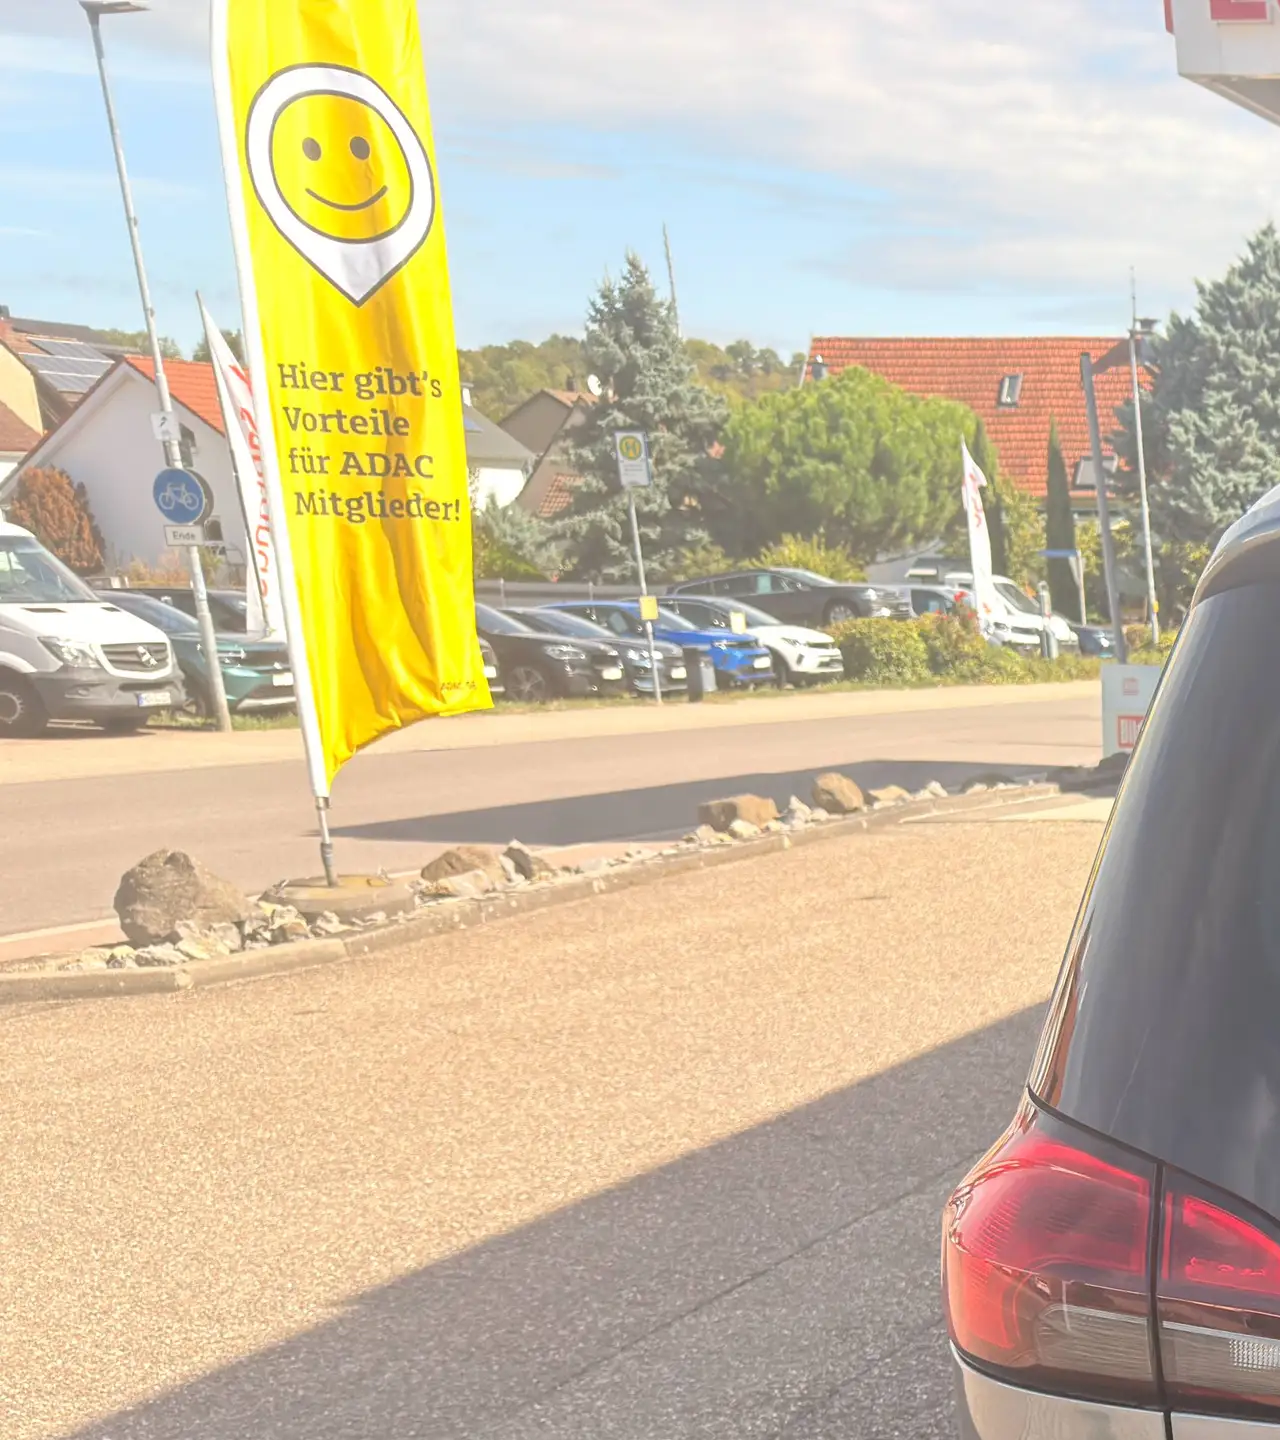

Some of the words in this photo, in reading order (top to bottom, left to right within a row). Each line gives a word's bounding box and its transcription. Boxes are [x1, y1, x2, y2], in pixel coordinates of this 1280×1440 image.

[277, 361, 345, 392] Hier
[354, 366, 443, 400] gibt's
[282, 405, 410, 437] Vorteile
[288, 446, 331, 474] für
[339, 451, 434, 479] ADAC
[294, 488, 461, 524] Mitglieder!
[171, 529, 197, 542] Ende
